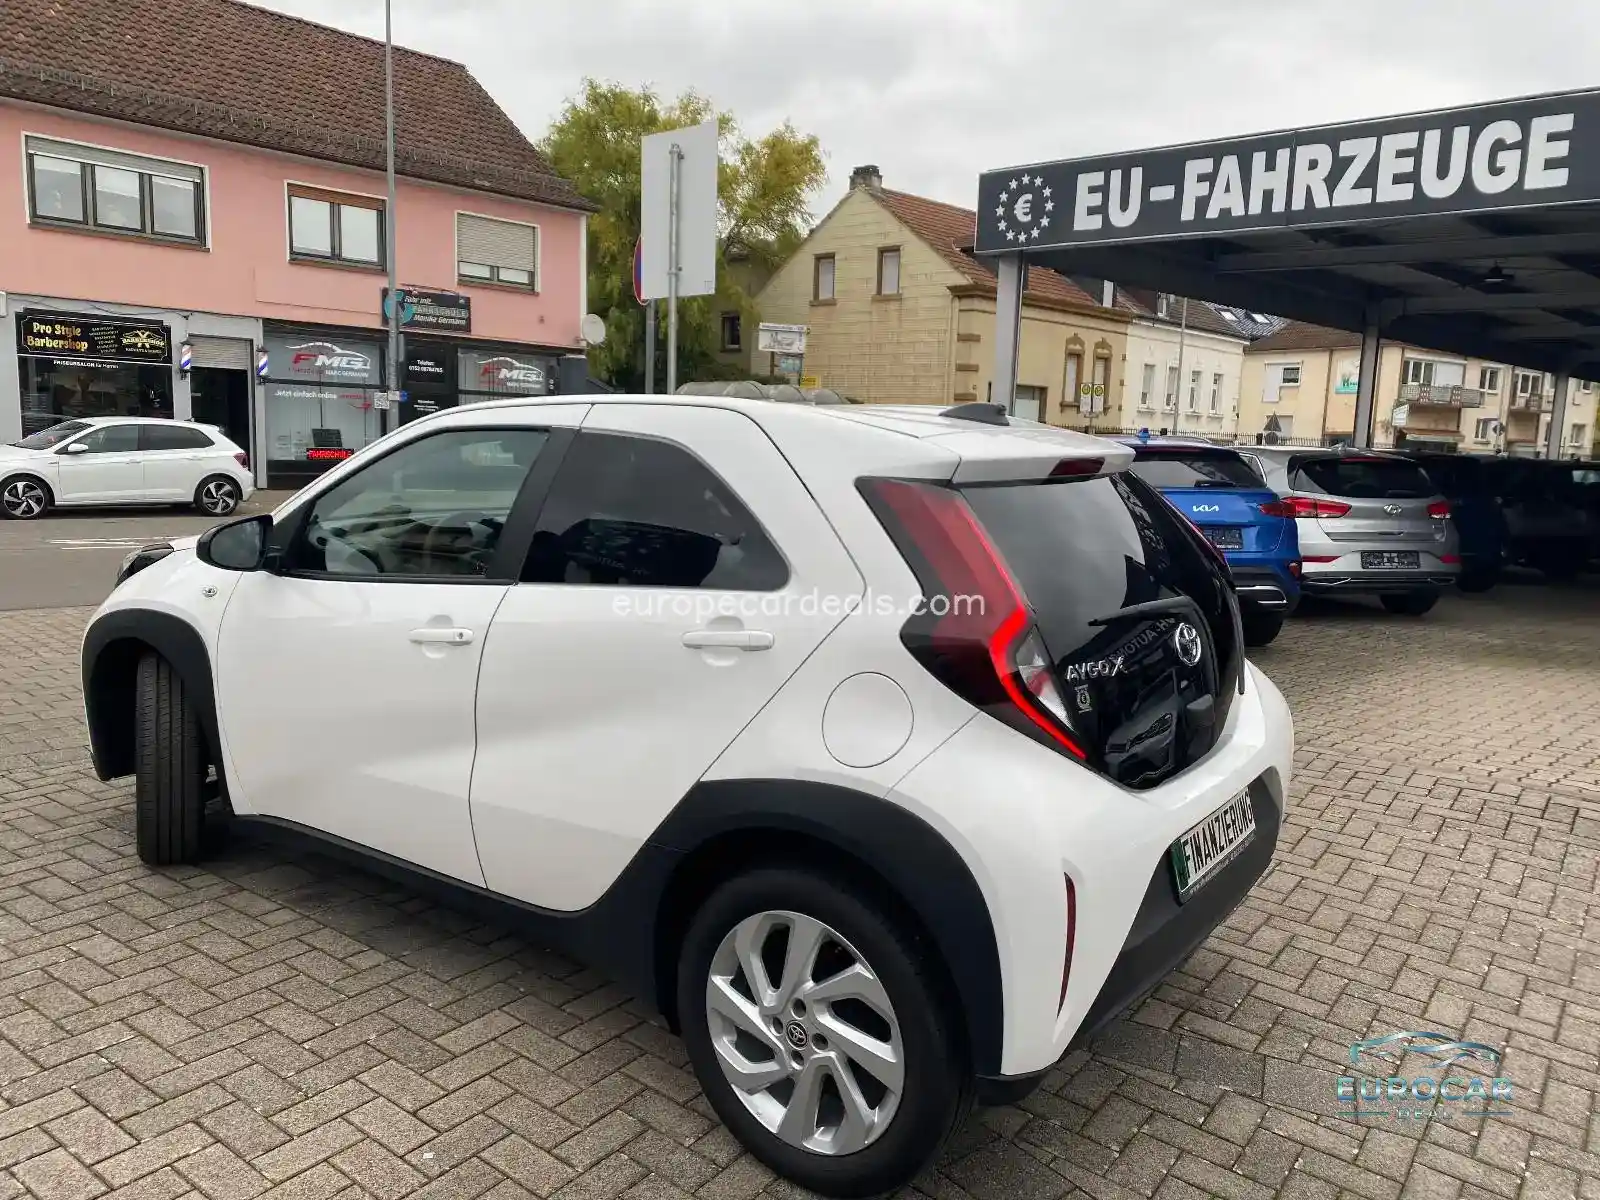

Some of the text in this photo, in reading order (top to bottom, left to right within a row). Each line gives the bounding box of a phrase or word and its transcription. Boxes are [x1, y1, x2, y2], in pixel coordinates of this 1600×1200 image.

[1073, 113, 1575, 232] EU-FAHRZEUGE
[26, 335, 88, 352] Barbershop
[32, 322, 52, 334] Pro
[54, 324, 81, 338] Style
[1181, 789, 1253, 879] FINANZIERUNG
